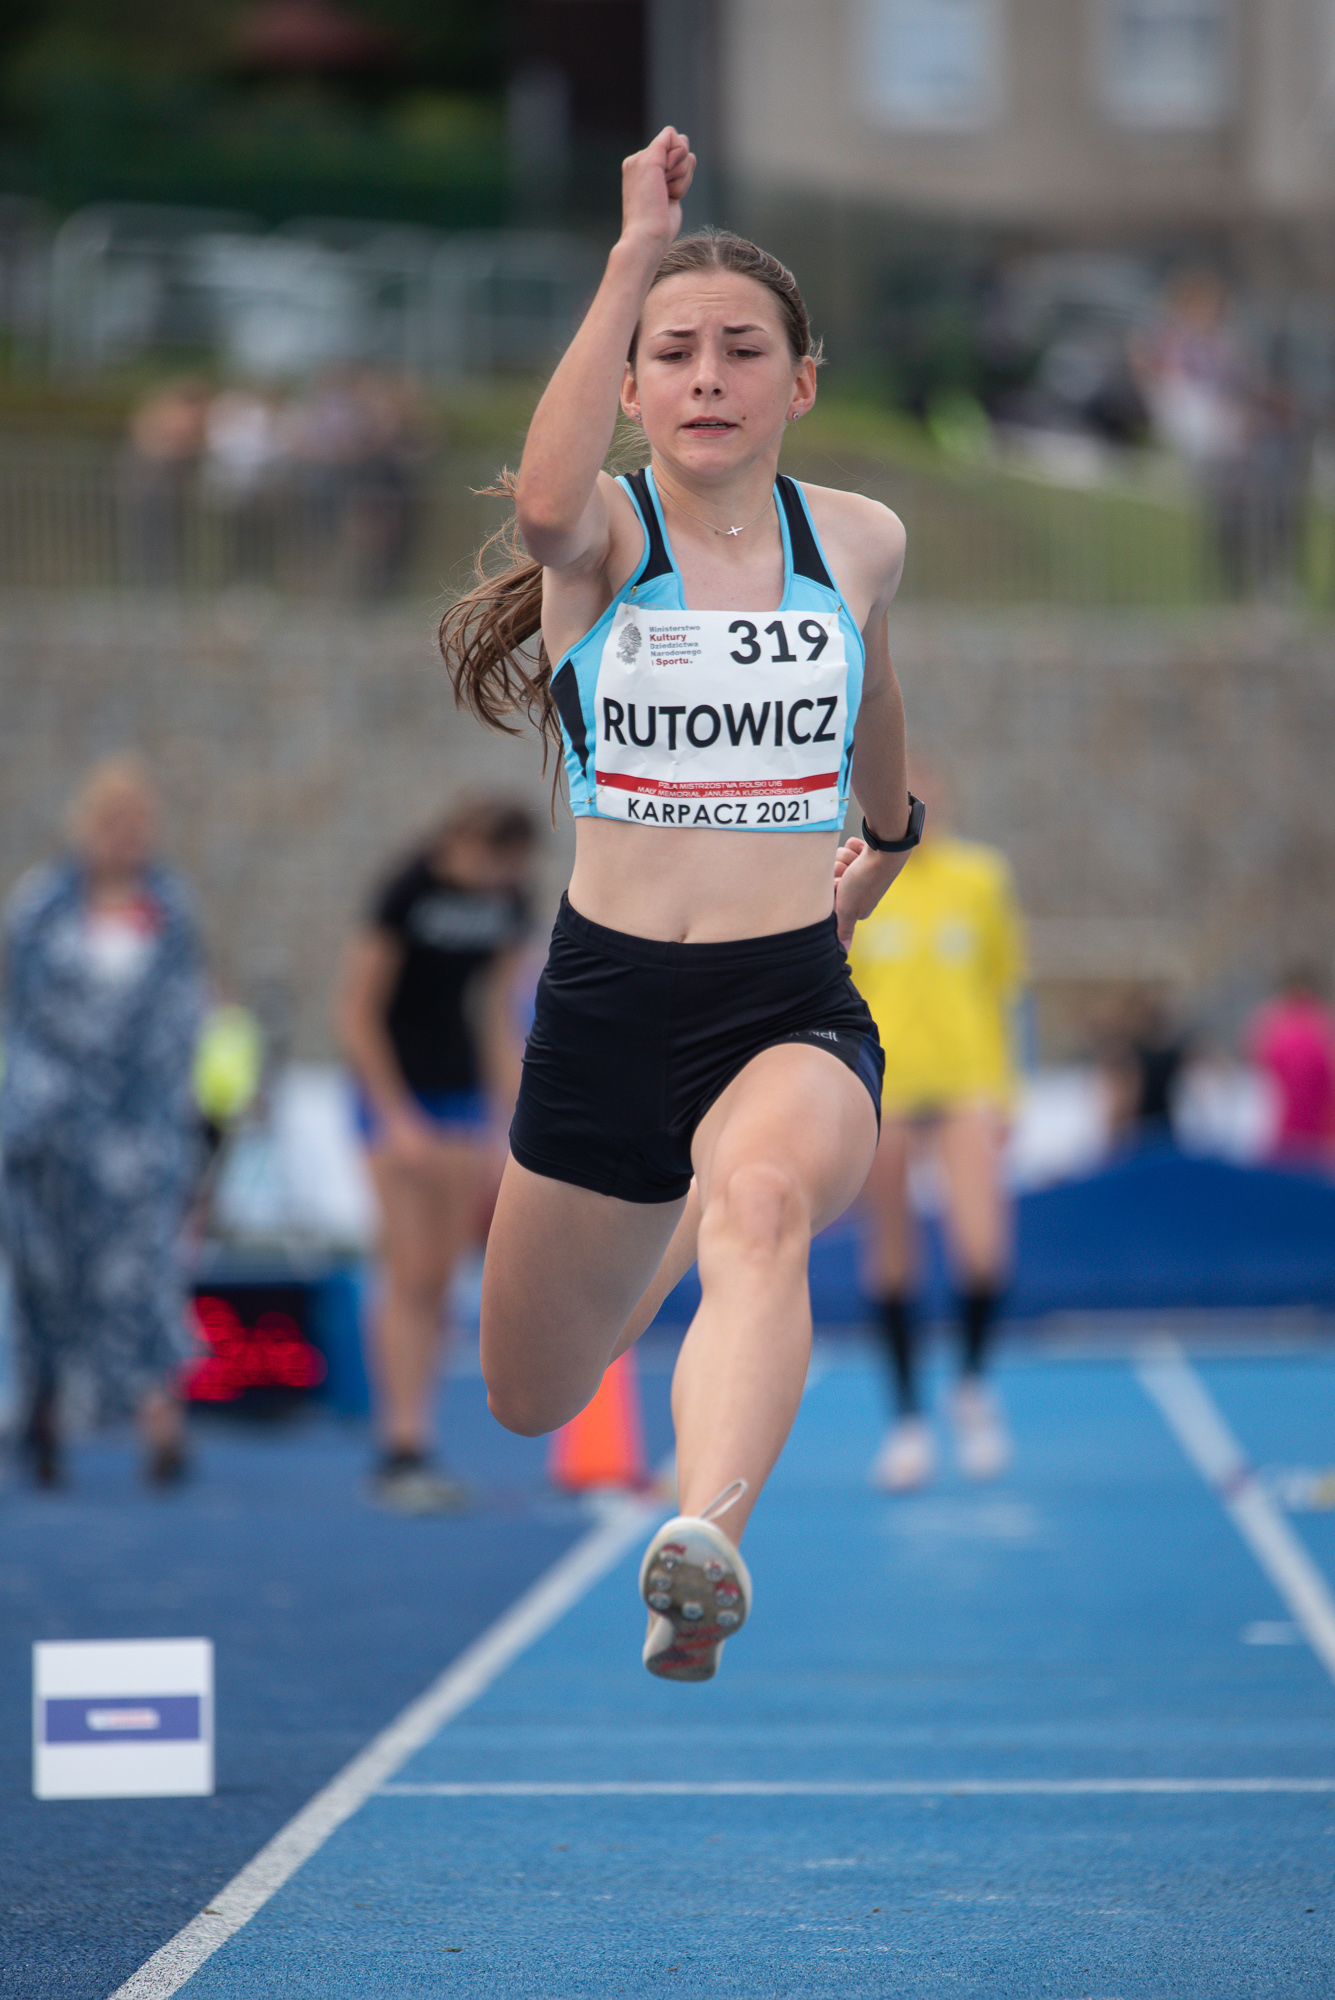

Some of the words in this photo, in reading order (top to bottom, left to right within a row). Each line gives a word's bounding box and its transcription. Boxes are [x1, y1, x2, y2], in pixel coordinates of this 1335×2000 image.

[649, 633, 687, 642] Kultury
[728, 619, 829, 665] 319
[655, 657, 693, 667] Sportu.
[603, 696, 838, 751] RUTOWICZ
[658, 781, 678, 790] PZLA
[679, 782, 738, 790] MISTRZOSTWA
[739, 781, 767, 789] POLSKI
[702, 790, 741, 798] JANUSZA
[627, 797, 748, 824] KARPACZ
[756, 799, 810, 824] 2021
